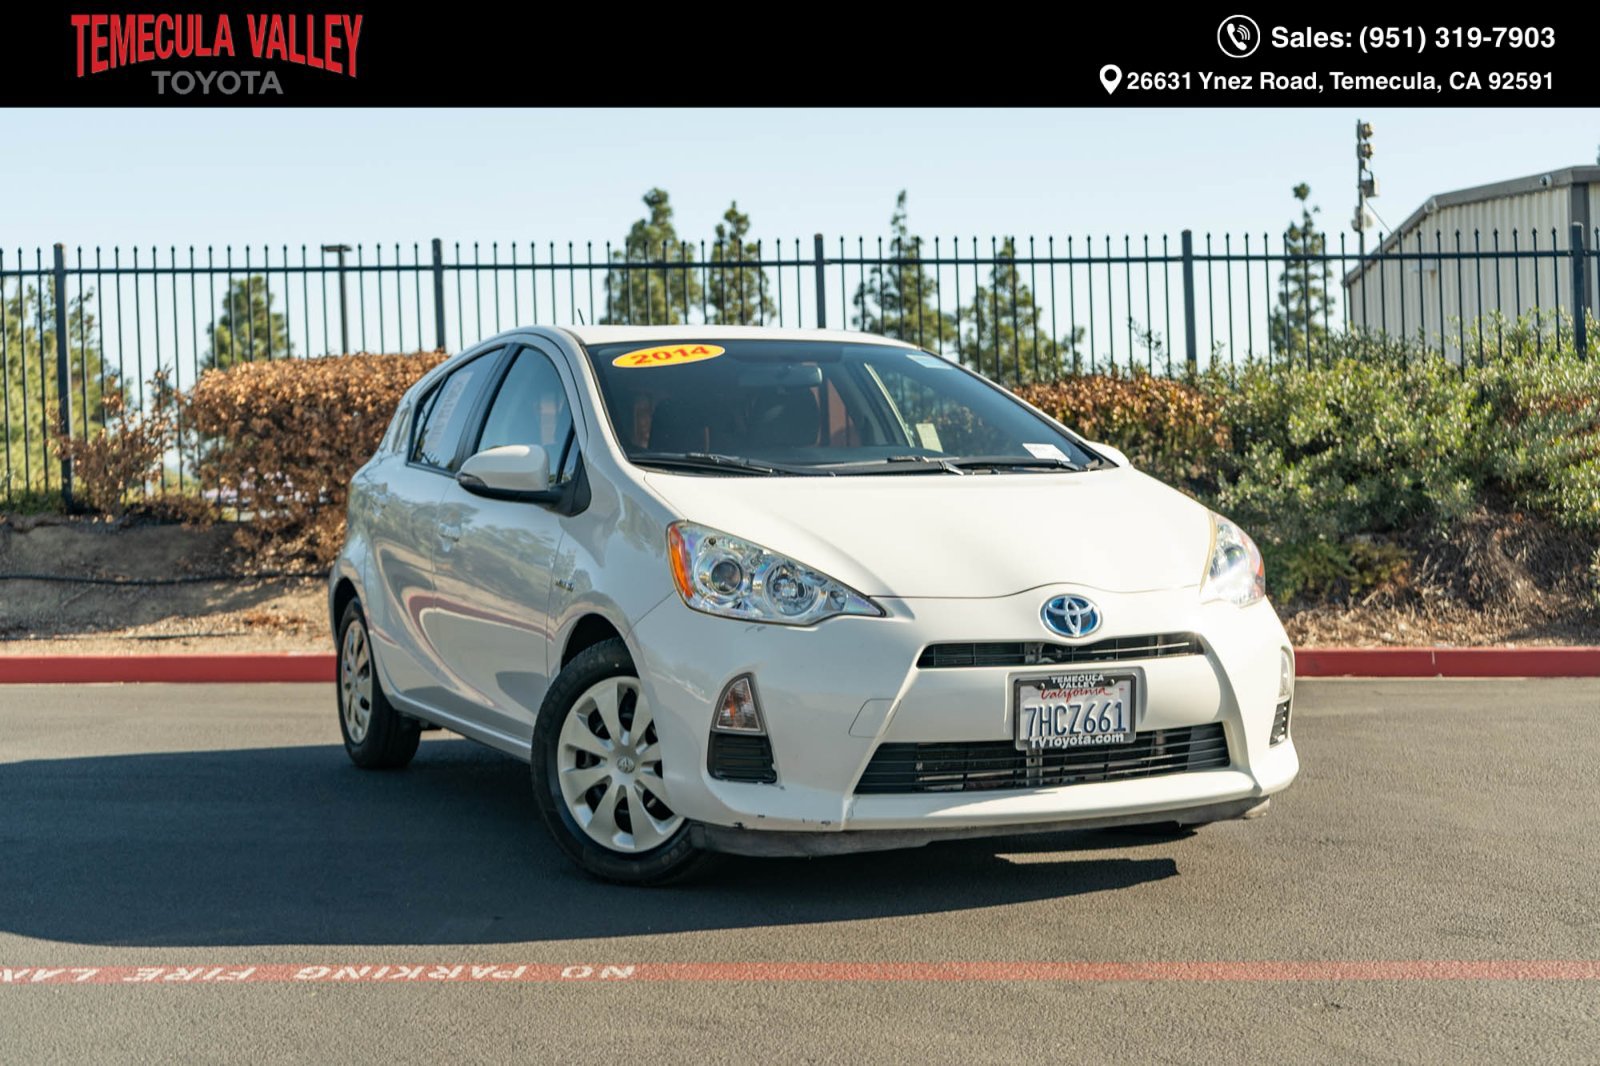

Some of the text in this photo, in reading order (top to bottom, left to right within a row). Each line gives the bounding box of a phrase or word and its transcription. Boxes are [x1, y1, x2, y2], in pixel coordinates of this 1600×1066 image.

[631, 346, 710, 365] 2014
[1051, 674, 1105, 684] TEMECULA
[1059, 681, 1096, 689] VALLEY
[1041, 687, 1113, 702] California
[1024, 701, 1126, 736] 7HCZ661
[1030, 733, 1124, 749] TVToyota.com
[123, 967, 257, 982] FIRE
[295, 965, 528, 980] PARKING
[560, 965, 636, 979] NO
